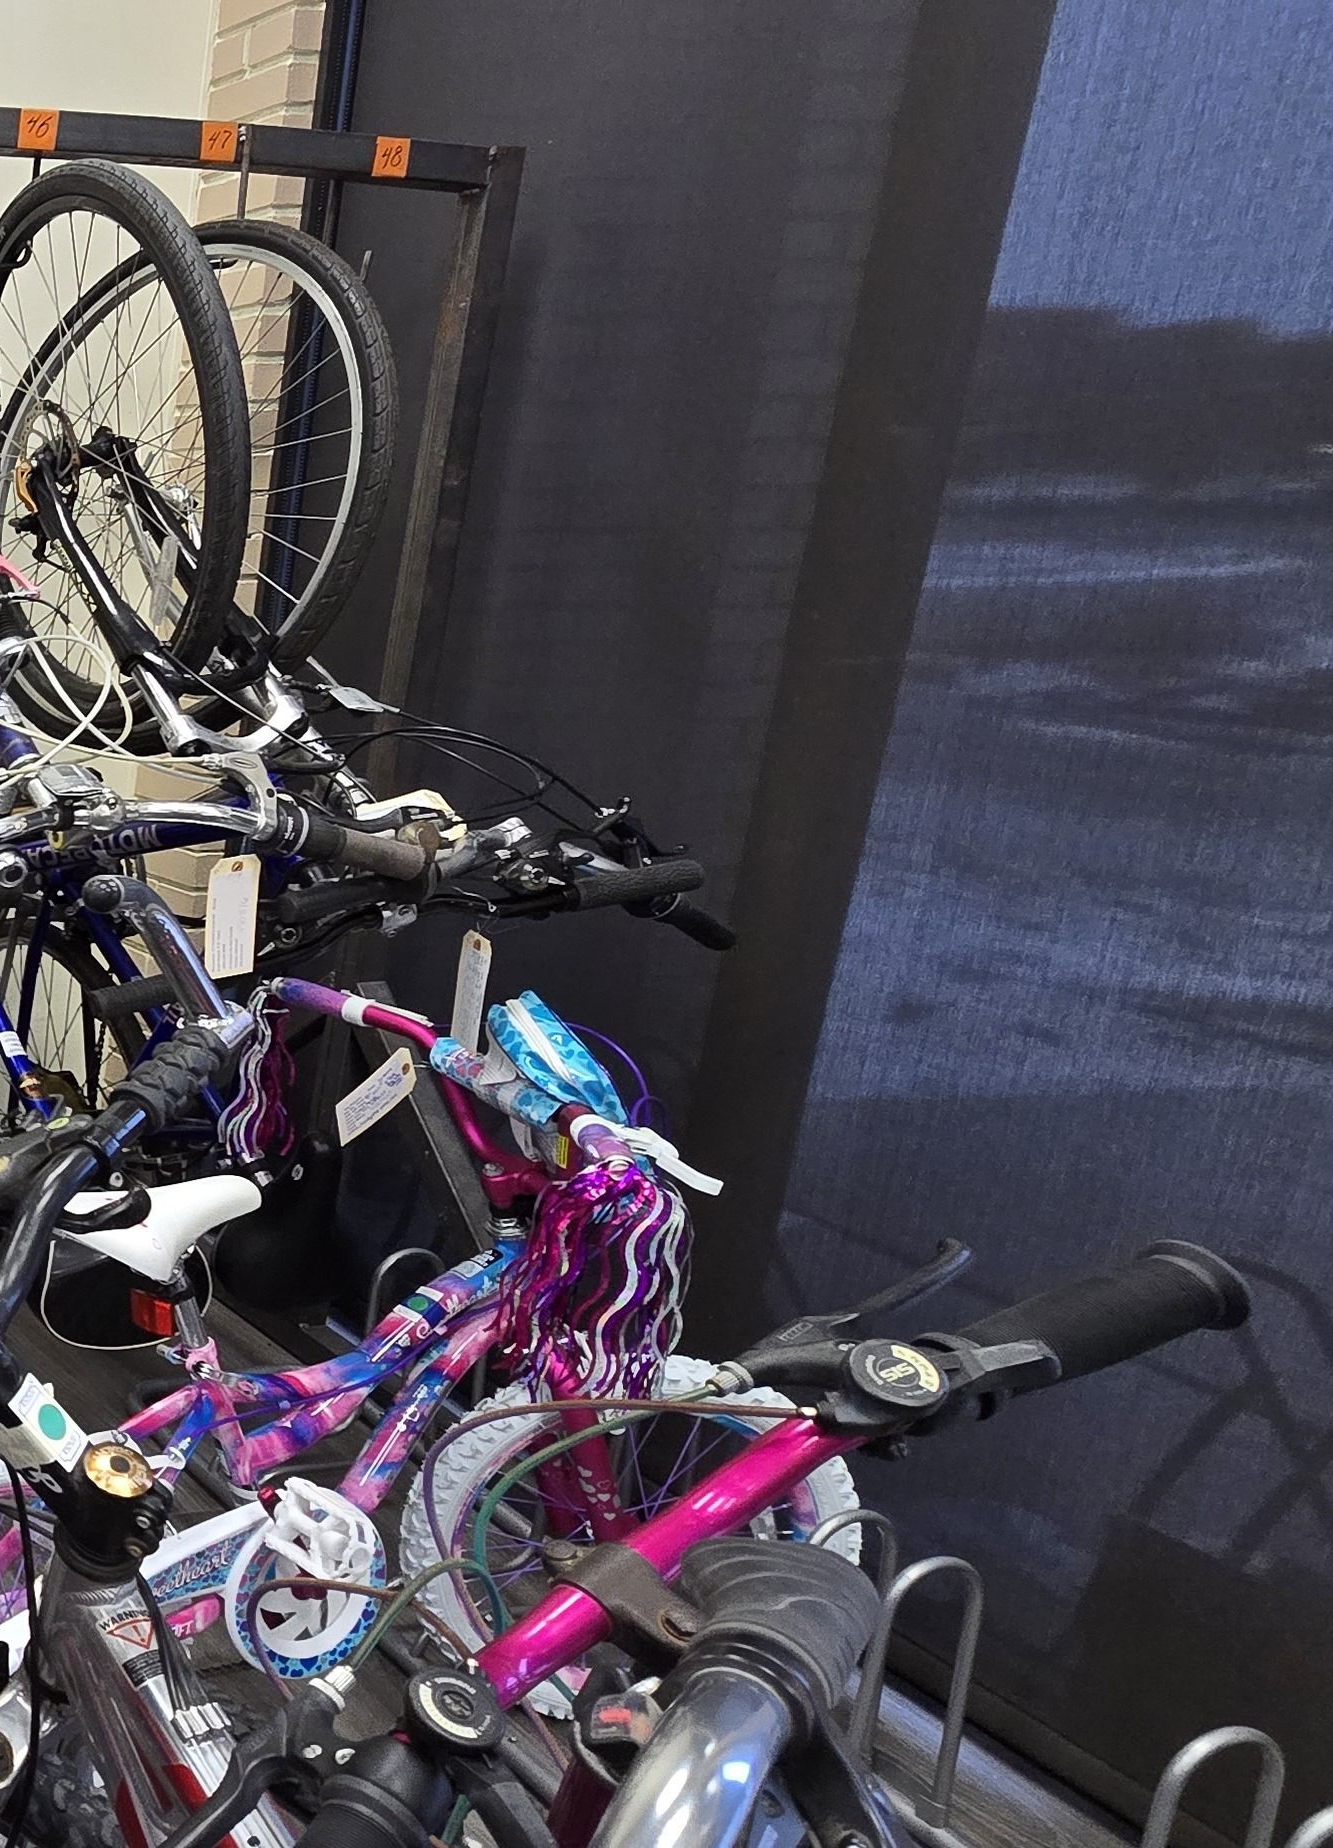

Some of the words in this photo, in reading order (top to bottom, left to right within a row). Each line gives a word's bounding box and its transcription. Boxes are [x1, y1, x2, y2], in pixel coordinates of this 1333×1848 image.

[27, 113, 51, 139] 46
[209, 123, 231, 151] 47
[381, 143, 404, 169] 48
[878, 1362, 916, 1383] SIS
